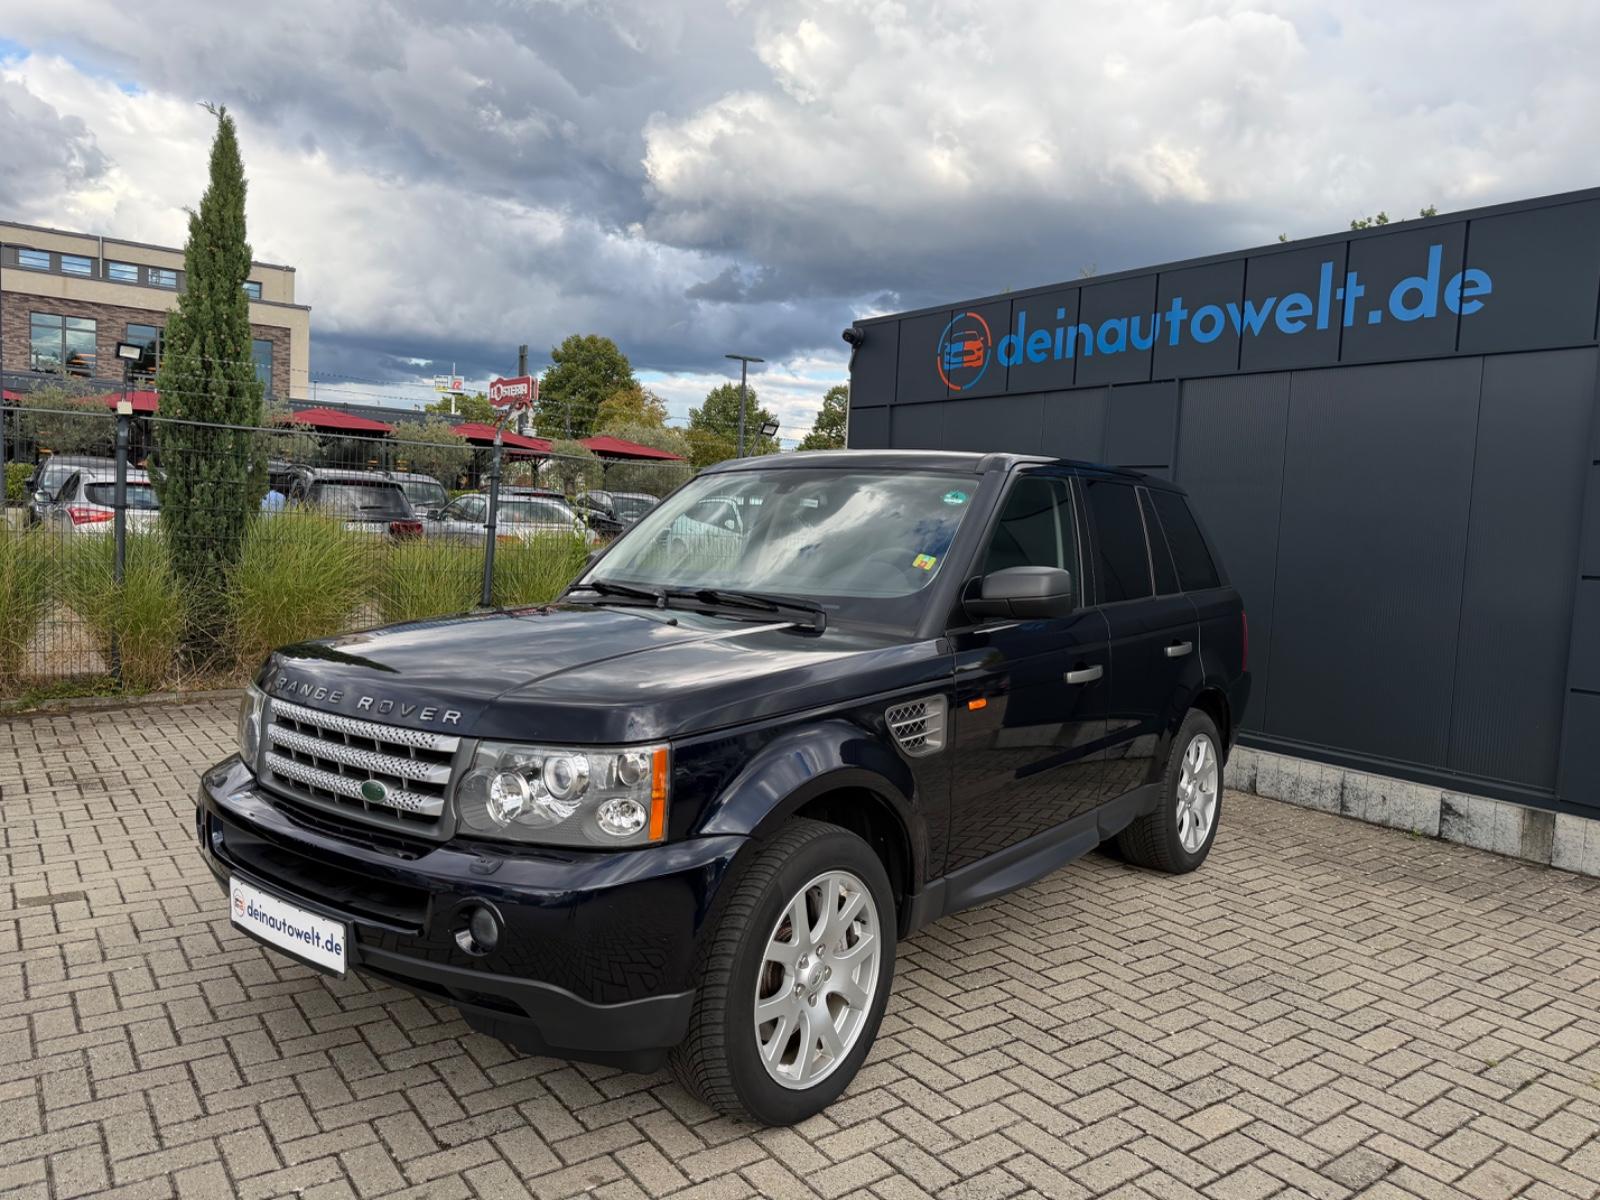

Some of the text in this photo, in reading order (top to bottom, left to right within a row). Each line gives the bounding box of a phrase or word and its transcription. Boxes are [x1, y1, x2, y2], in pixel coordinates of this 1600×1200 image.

[997, 243, 1492, 368] deinautowelt.de
[275, 677, 462, 725] RANGE ROVER
[246, 899, 342, 956] deinautowelt.de
